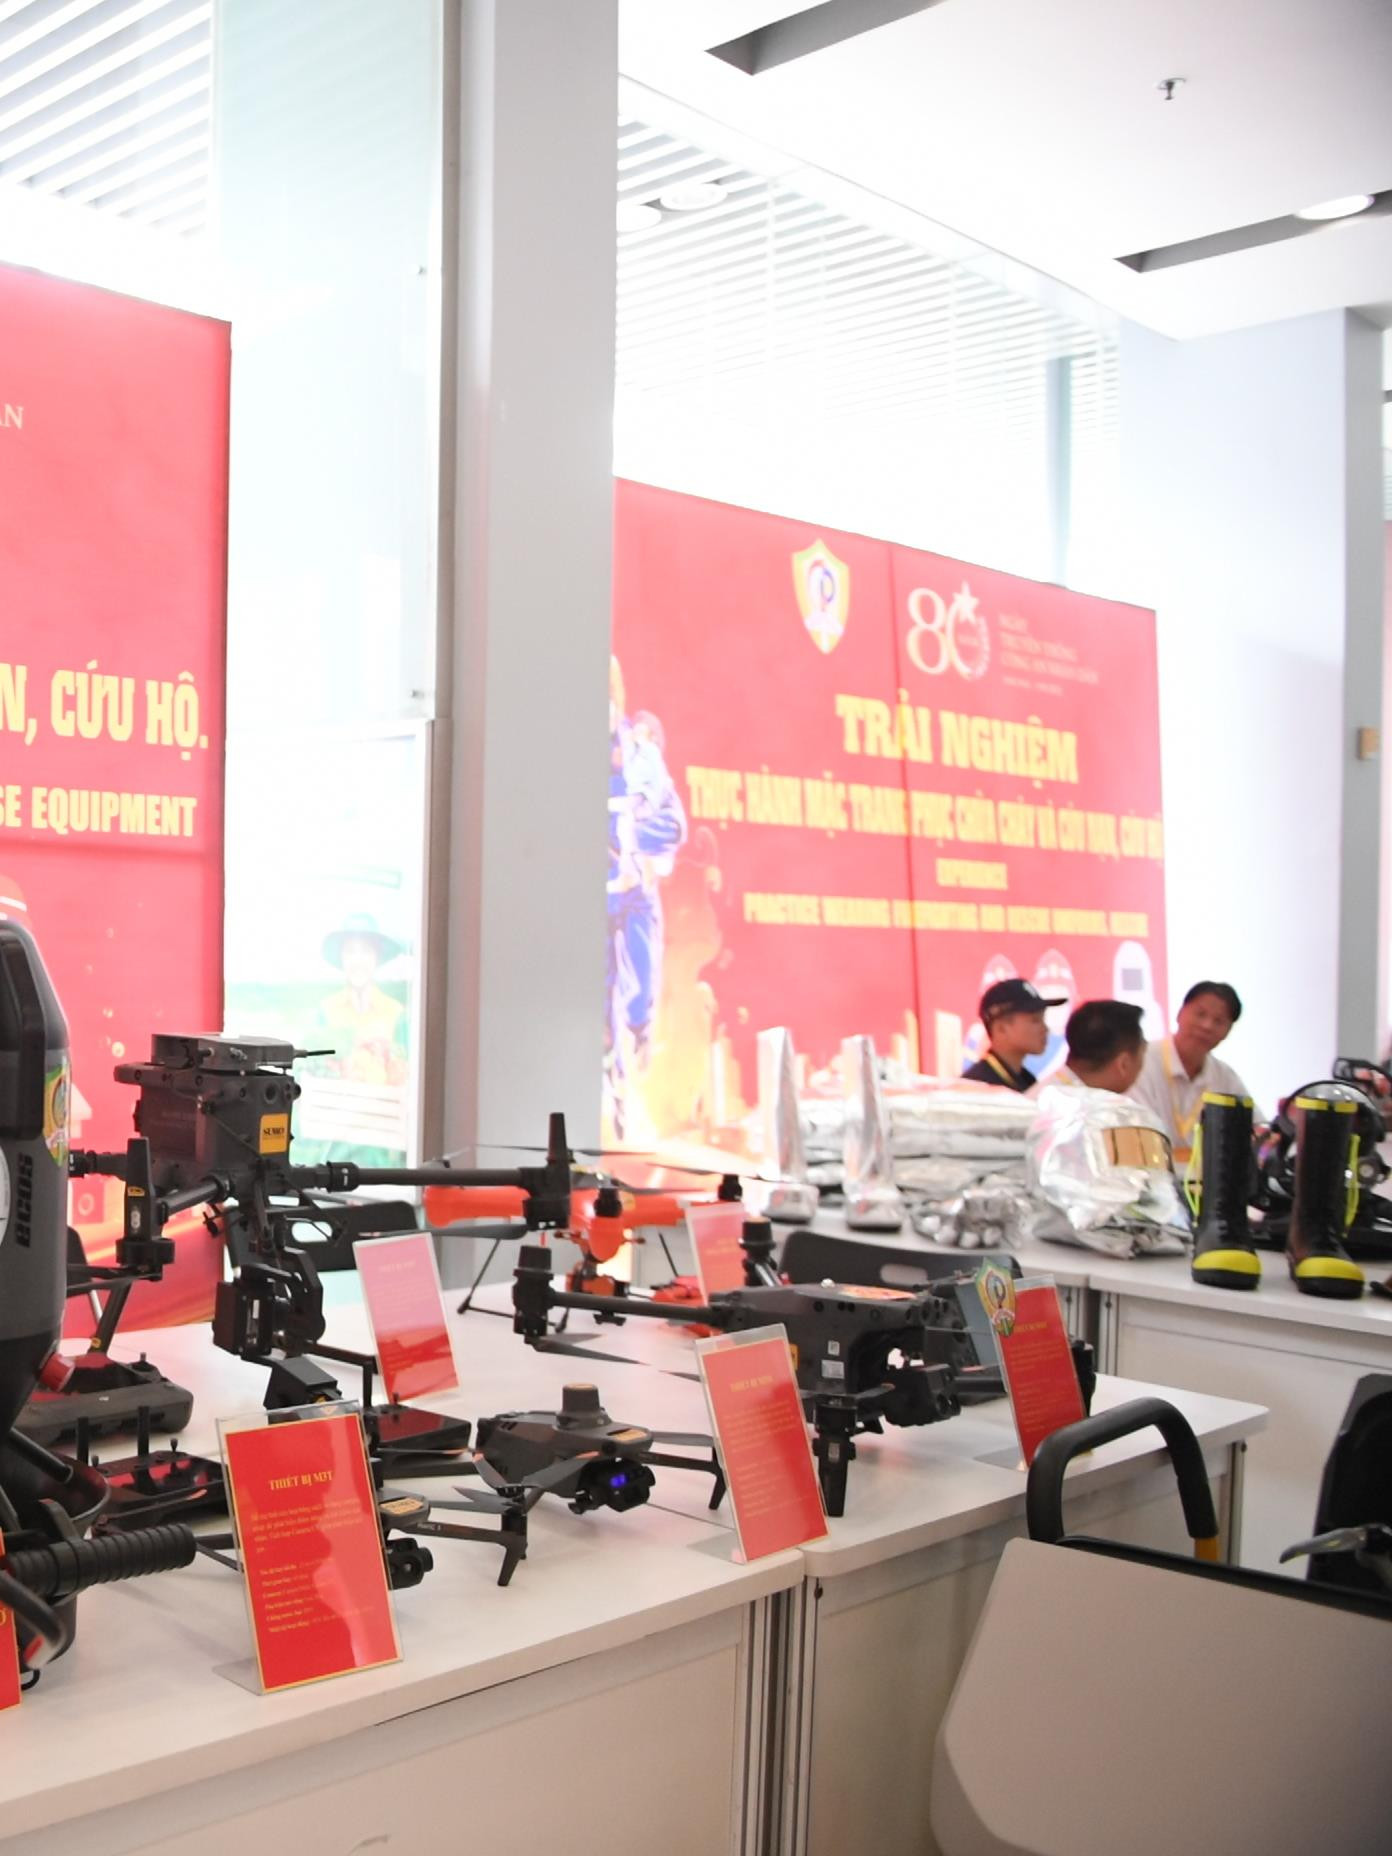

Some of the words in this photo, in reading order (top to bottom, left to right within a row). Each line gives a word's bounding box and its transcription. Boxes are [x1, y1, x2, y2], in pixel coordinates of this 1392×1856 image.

[50, 659, 135, 742] CỨU
[145, 671, 209, 761] HỘ.
[939, 711, 1079, 789] NGHIỆM
[32, 786, 198, 837] EQUIPMENT
[269, 1474, 298, 1491] THIẾT
